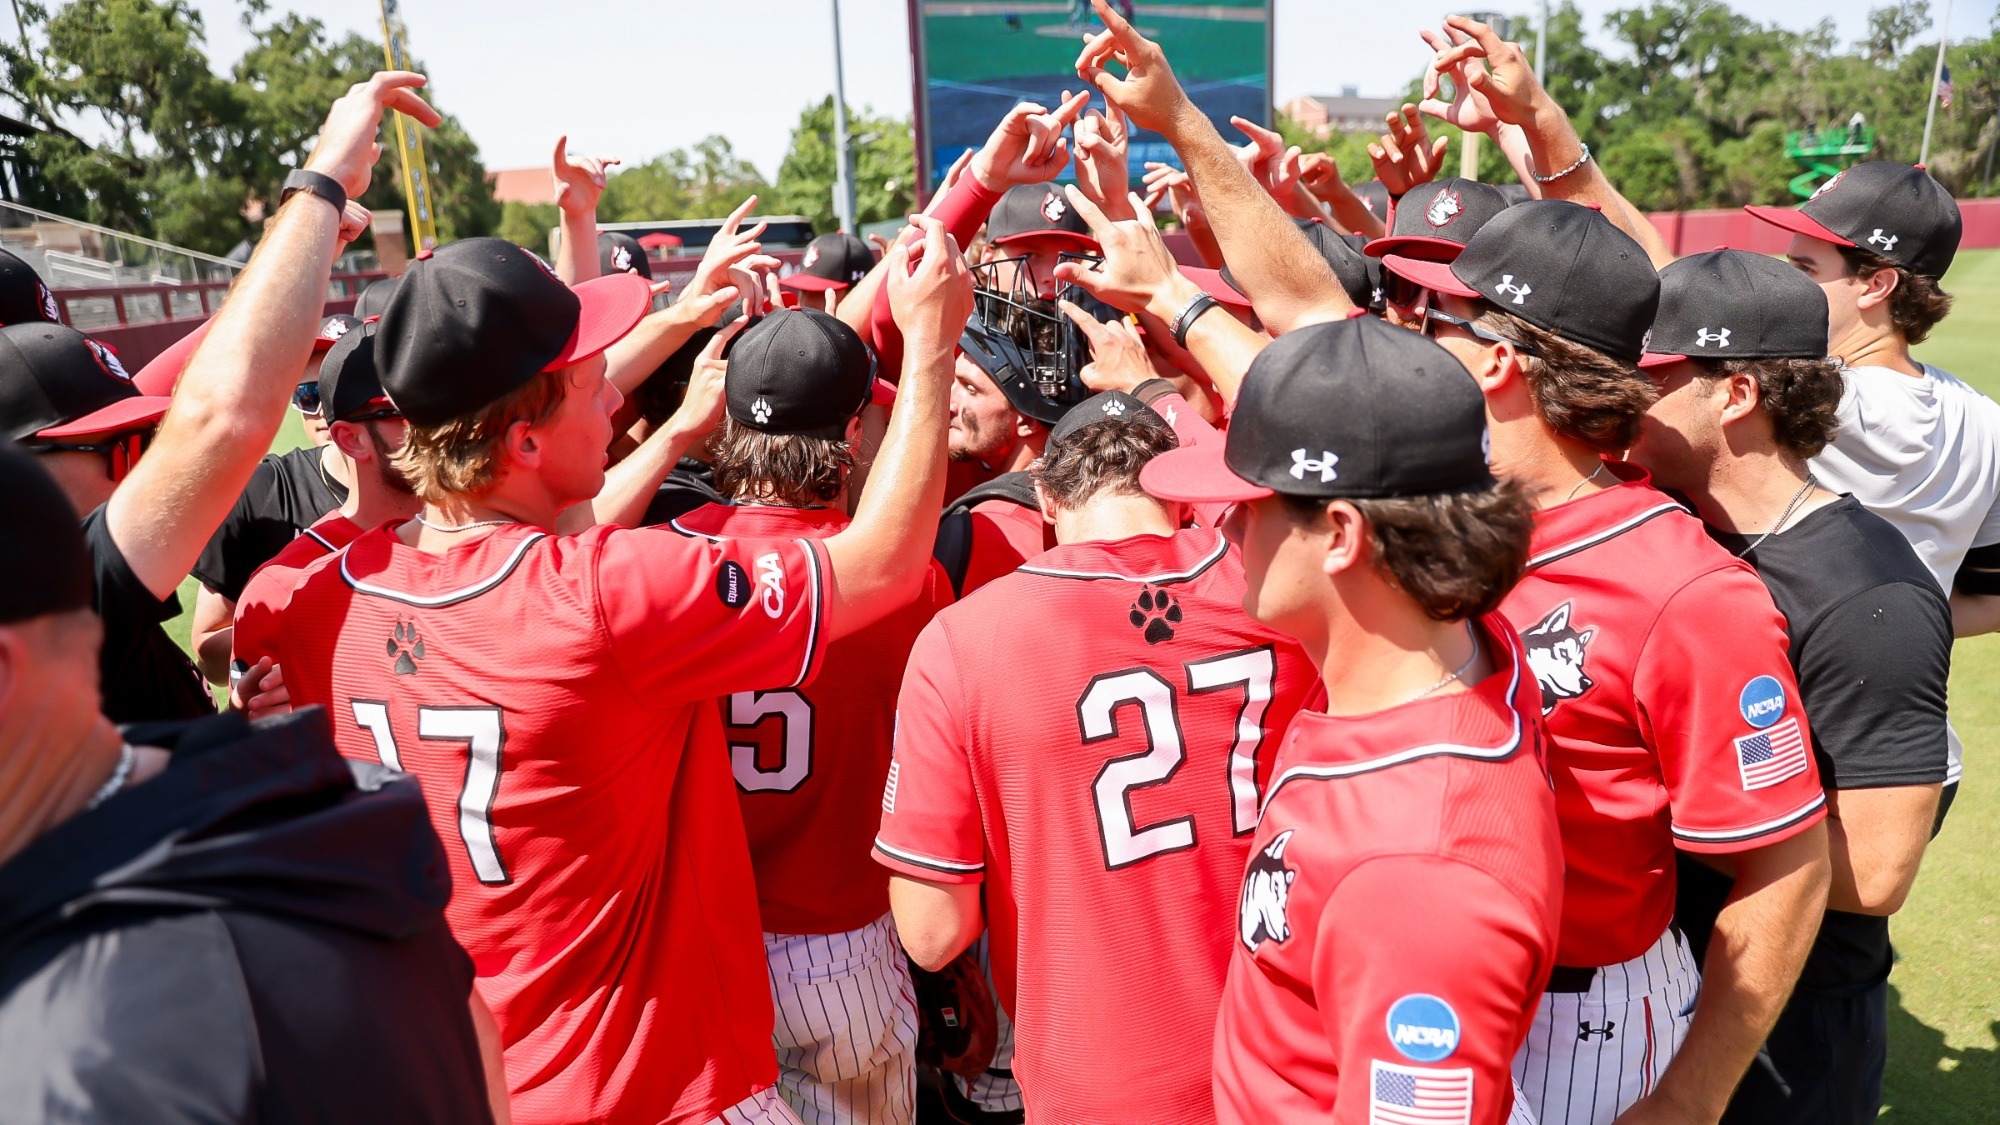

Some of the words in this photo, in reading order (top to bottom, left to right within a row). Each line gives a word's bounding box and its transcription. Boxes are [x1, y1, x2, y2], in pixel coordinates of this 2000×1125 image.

[727, 564, 738, 604] EQUALITY
[756, 552, 785, 619] CAA
[1747, 695, 1783, 719] NCAA
[727, 687, 815, 795] 5
[1076, 642, 1278, 871] 27
[1394, 1023, 1456, 1050] NCAA
